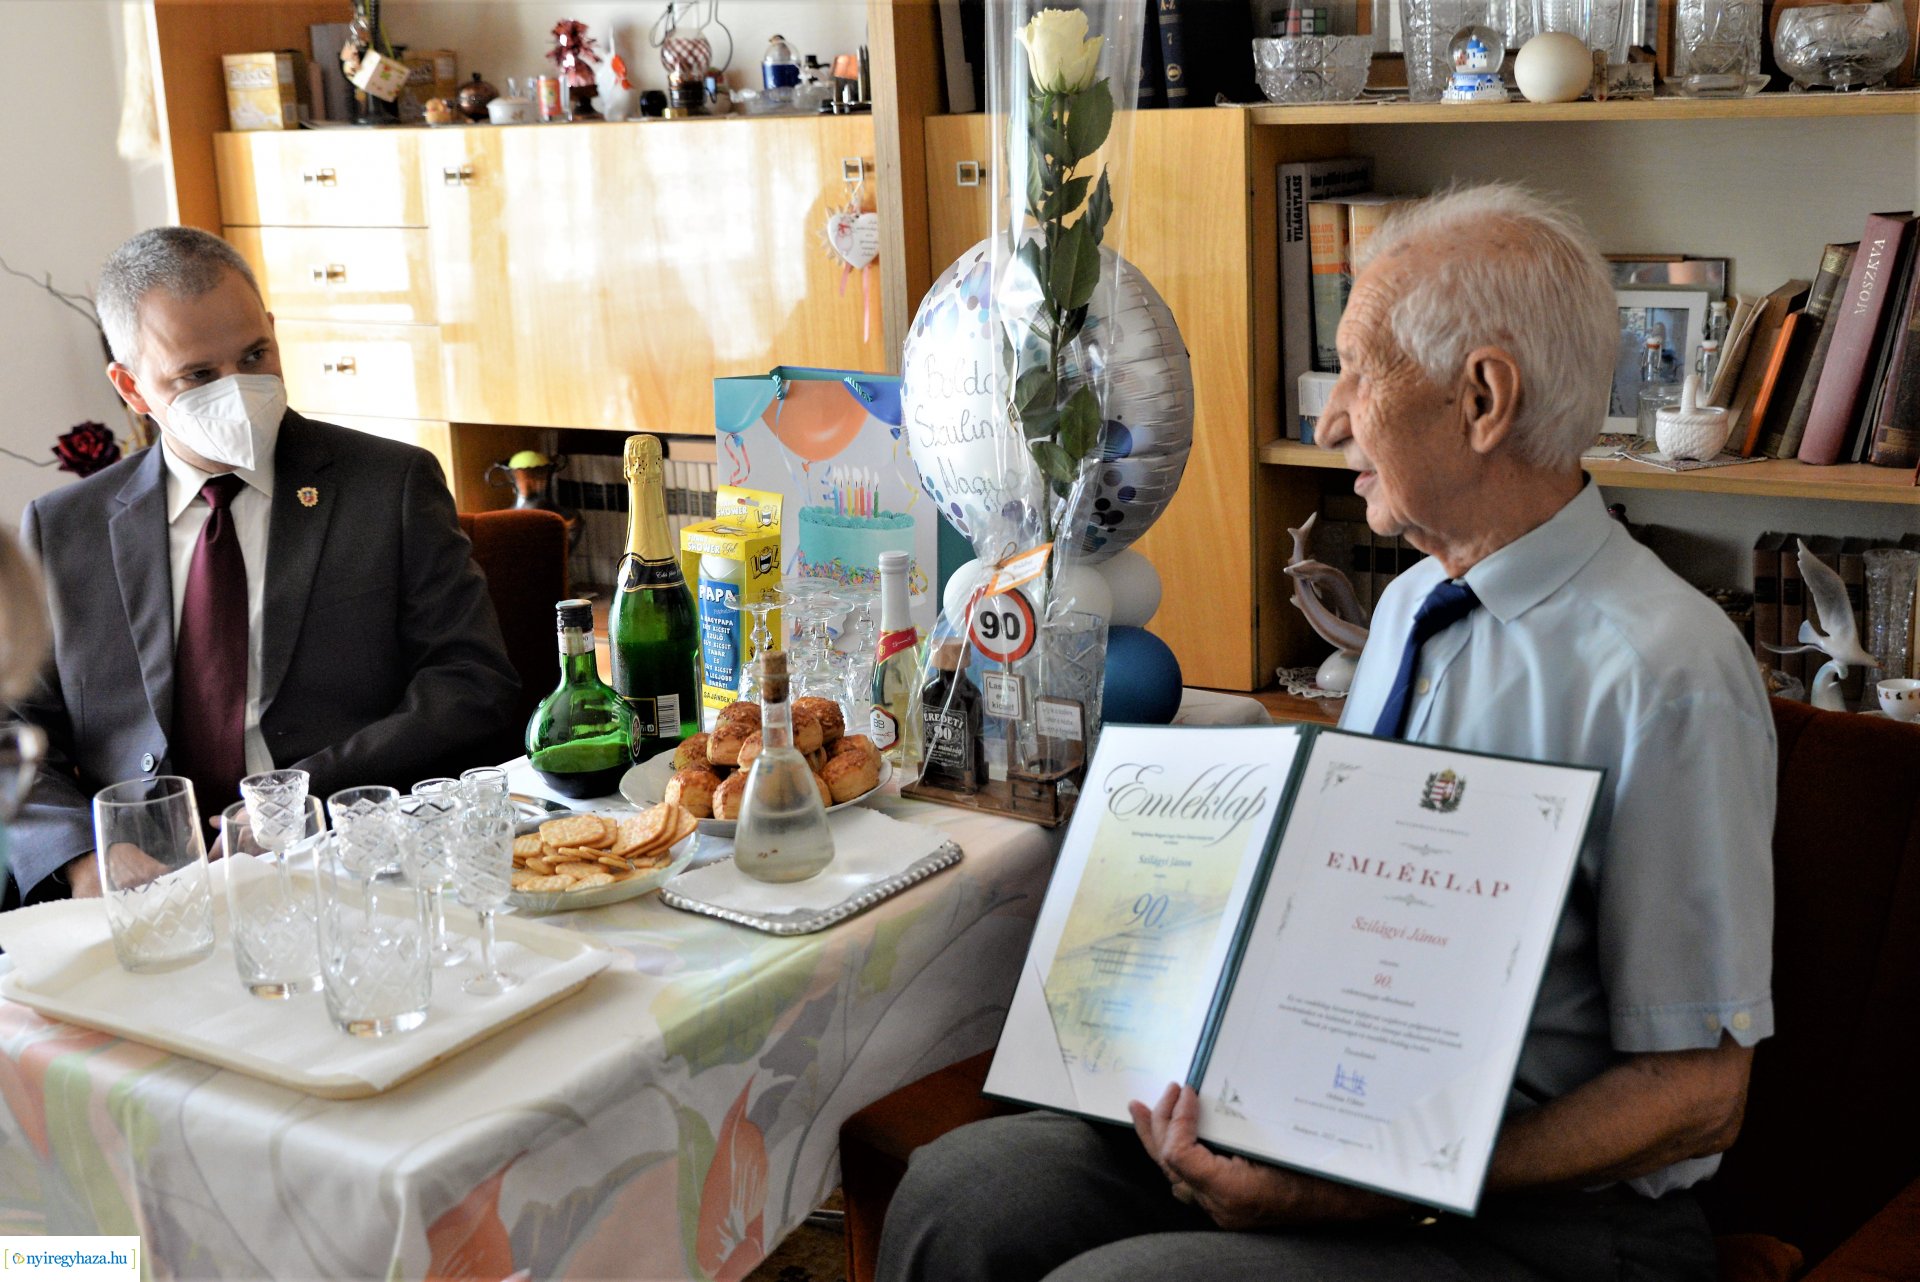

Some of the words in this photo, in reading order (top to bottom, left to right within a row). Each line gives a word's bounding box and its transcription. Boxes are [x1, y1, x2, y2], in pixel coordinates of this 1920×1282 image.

[1854, 239, 1886, 316] MOSZKVA
[687, 542, 721, 555] SHOWER
[699, 584, 737, 603] PAPA
[979, 611, 1021, 641] 90
[1104, 763, 1270, 848] Emléklap
[1326, 851, 1511, 898] EMLÉKLAP
[1125, 893, 1170, 929] 90.
[1352, 916, 1406, 940] Szilágyi
[1406, 928, 1449, 947] János
